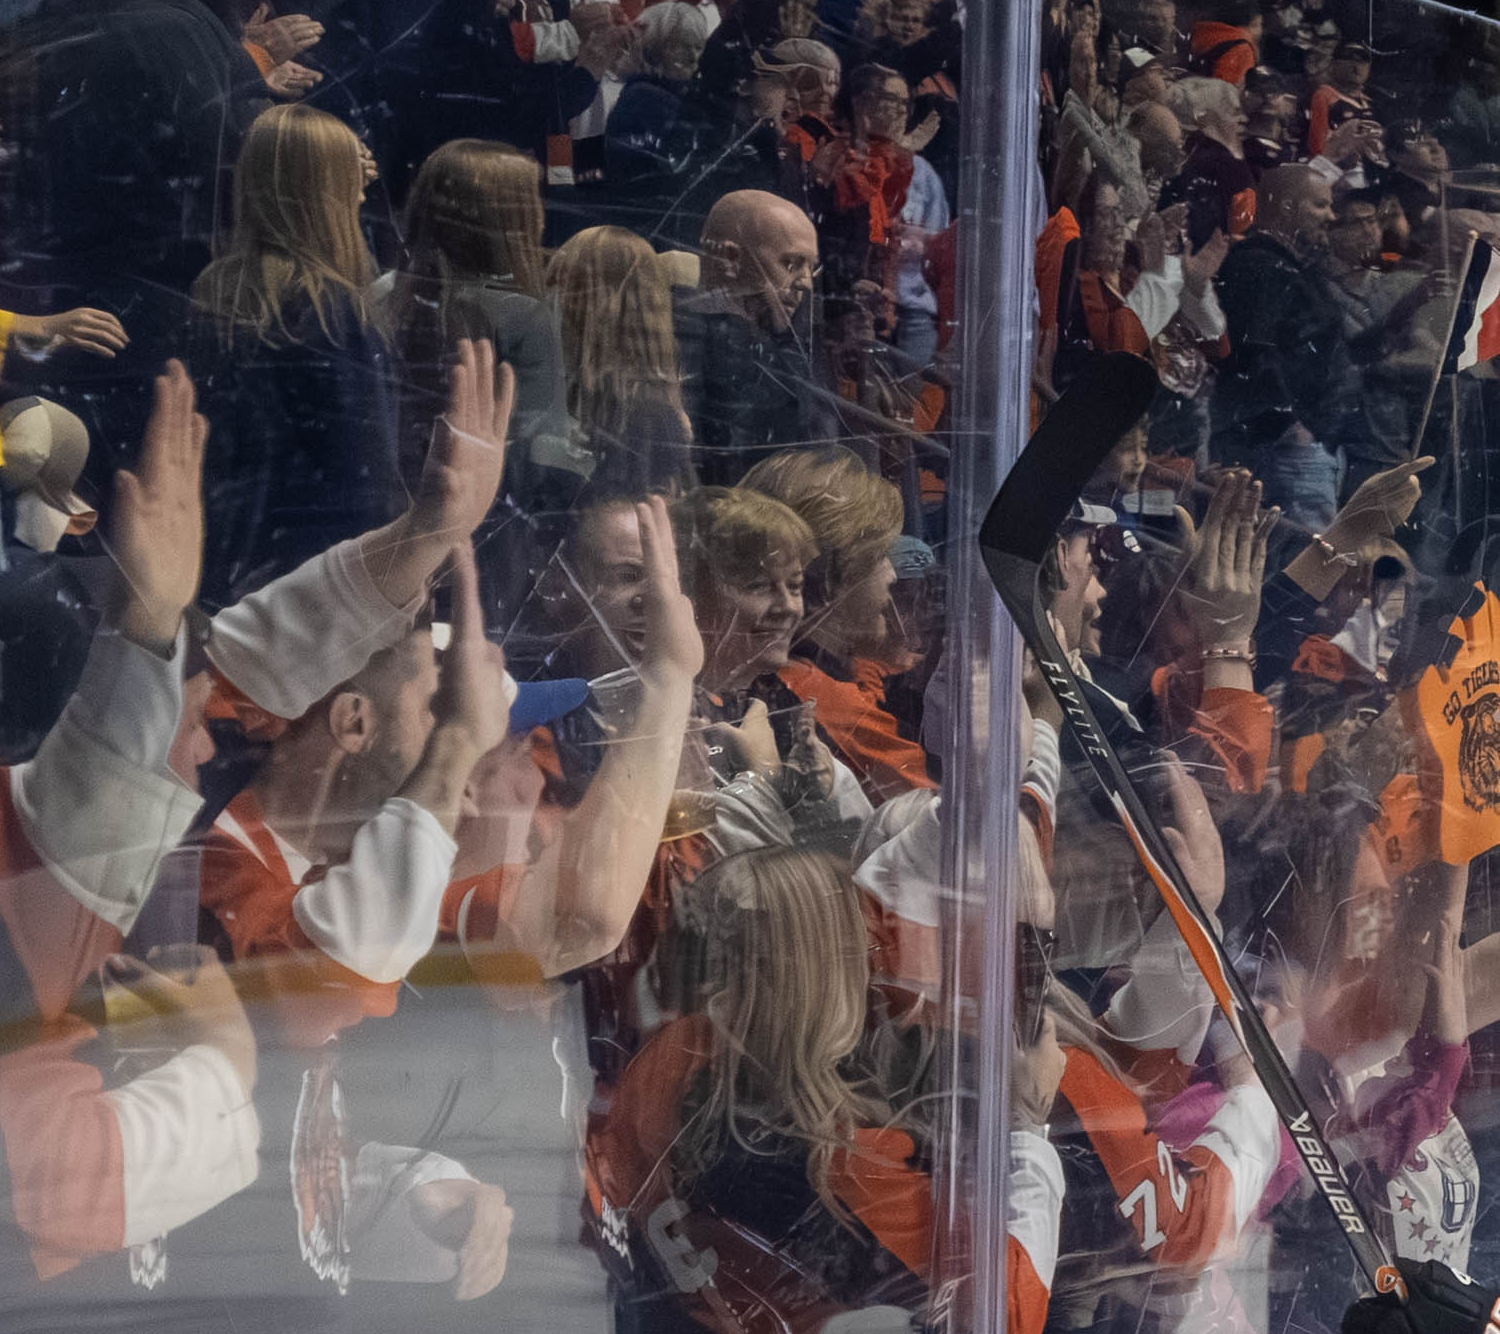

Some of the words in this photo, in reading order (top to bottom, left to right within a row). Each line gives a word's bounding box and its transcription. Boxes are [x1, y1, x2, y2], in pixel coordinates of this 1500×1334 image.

[1040, 659, 1109, 759] FLYLITE
[1443, 691, 1462, 727] GO
[1118, 1140, 1189, 1254] 72
[1296, 1136, 1366, 1237] BAUER
